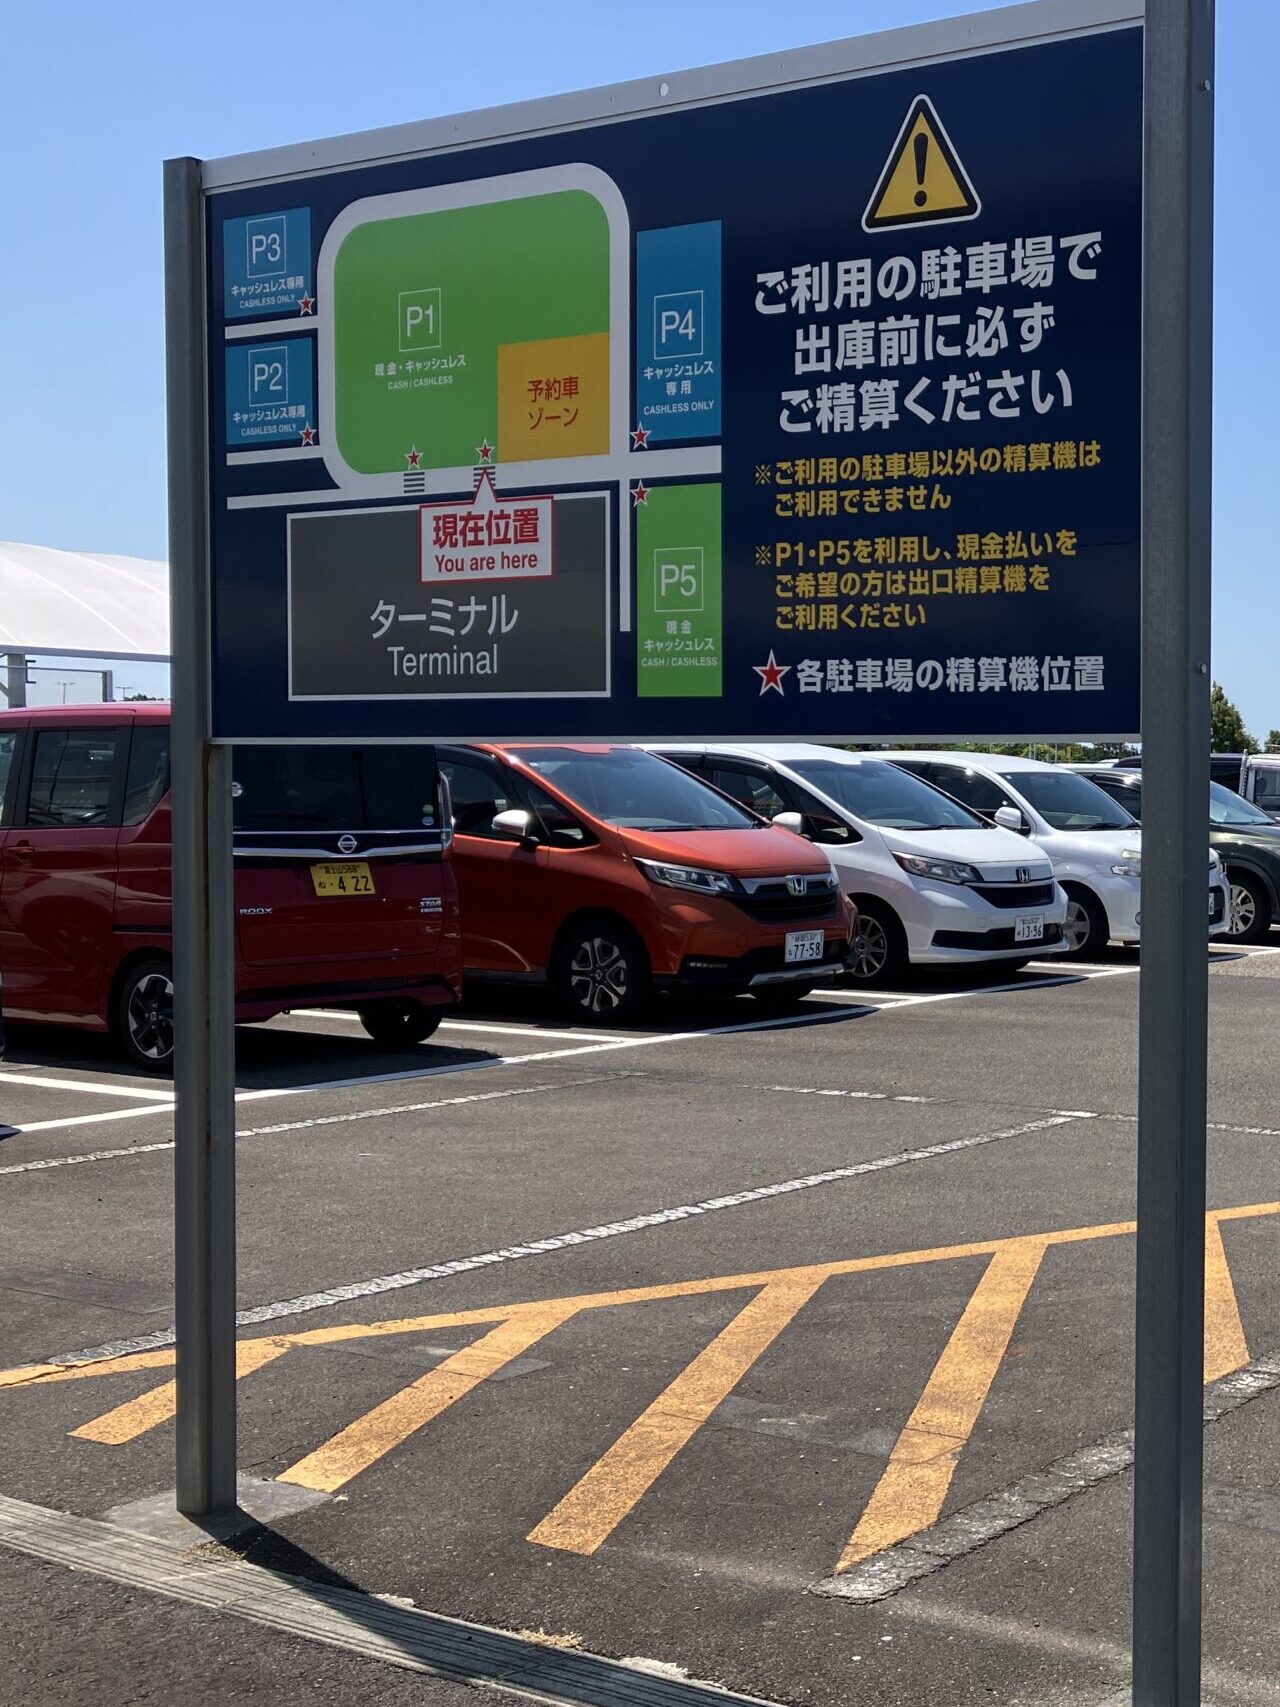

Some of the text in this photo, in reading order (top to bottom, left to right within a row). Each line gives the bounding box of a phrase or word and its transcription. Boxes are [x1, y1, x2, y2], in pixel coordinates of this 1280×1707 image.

[252, 233, 280, 263] P3
[231, 276, 304, 297] キャッシュレス専用
[754, 231, 1102, 315] ご利用の駐車場で
[240, 294, 295, 309] CASHLESS ONLY
[407, 305, 433, 337] P1
[661, 309, 695, 343] P4
[794, 301, 1056, 375] 出庫前に必ず
[254, 362, 282, 392] P2
[374, 354, 466, 377] 現金・キャッシュレス
[643, 361, 714, 380] キャッシュレス
[527, 376, 580, 403] 予約車
[666, 380, 691, 396] 専用
[779, 368, 1073, 434] ご精算ください
[233, 405, 306, 423] キャッシュレス専用
[528, 407, 579, 431] ゾーン
[644, 400, 714, 415] CASHLESS ONLY
[240, 423, 297, 436] CASHLESS ONLY
[755, 440, 1101, 487] ※ご利用の駐車場以外の精算機は
[774, 483, 951, 518] ご利用できません
[433, 508, 539, 549] 現在位置
[434, 551, 538, 574] You are here
[661, 564, 696, 596] P5
[774, 565, 1049, 599] ご希望の方は出口精算機を
[369, 594, 519, 639] ターミナル
[774, 602, 926, 631] ご利用ください
[644, 638, 714, 652] キャッシュレス
[387, 644, 499, 677] Terminal
[796, 655, 1105, 693] 各駐車場の精算機位置
[793, 941, 820, 960] 77-58
